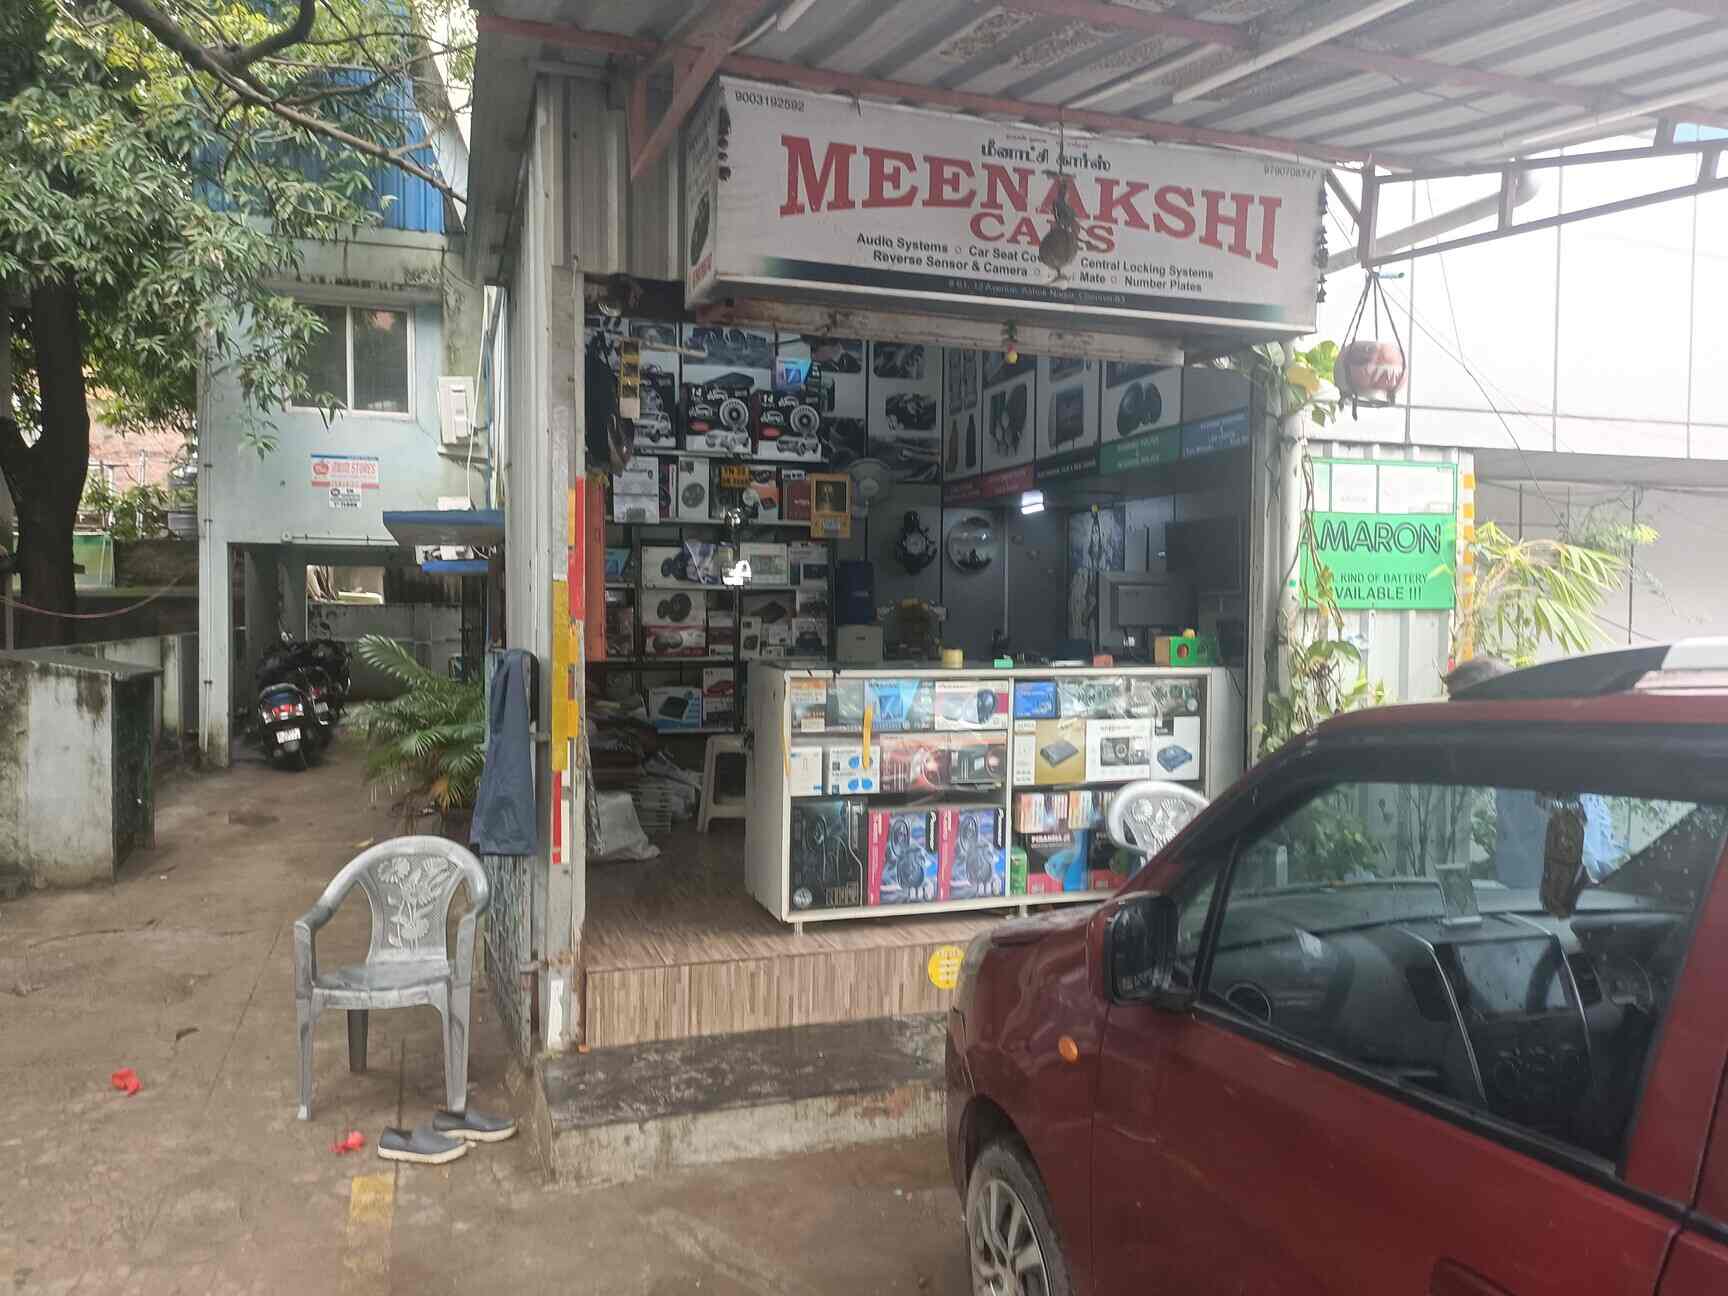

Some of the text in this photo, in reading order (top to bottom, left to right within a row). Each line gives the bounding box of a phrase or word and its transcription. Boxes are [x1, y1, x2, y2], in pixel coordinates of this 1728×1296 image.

[779, 132, 1282, 270] MEENAKSHI
[969, 210, 1116, 253] CAS
[856, 231, 893, 249] Audio
[896, 236, 948, 254] Systems
[968, 244, 990, 258] Car
[992, 247, 1018, 261] Seat
[1080, 256, 1120, 272] Central
[1123, 260, 1166, 278] Locking
[1168, 264, 1214, 281] Systems
[873, 249, 922, 266] Reverse
[926, 255, 969, 271] Sensor
[972, 260, 980, 272] &
[983, 261, 1028, 277] Camera
[1124, 275, 1167, 289] Number
[1170, 278, 1202, 292] Plates
[1300, 519, 1442, 554] AMARON
[1324, 585, 1405, 601] VAILABLE
[1340, 572, 1365, 584] KIND
[1367, 573, 1380, 584] OF
[1383, 573, 1427, 585] BATTERY
